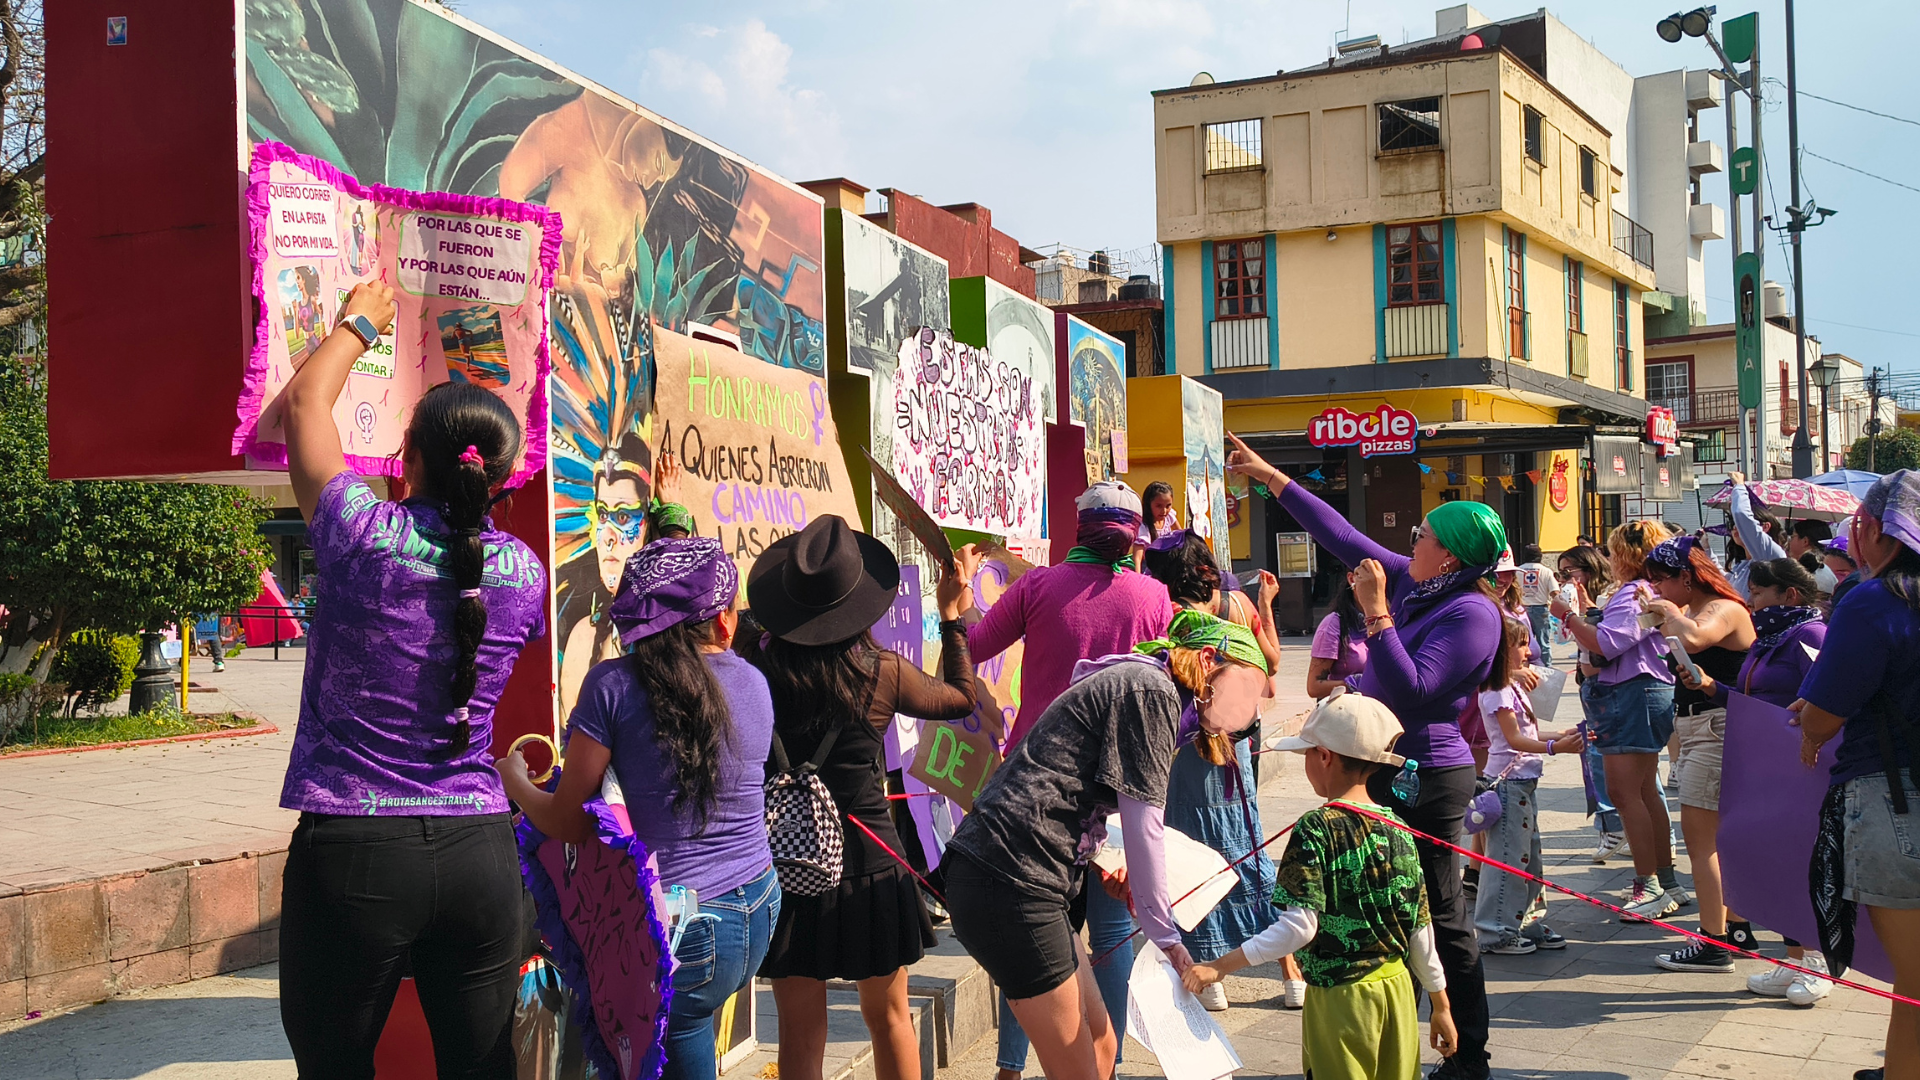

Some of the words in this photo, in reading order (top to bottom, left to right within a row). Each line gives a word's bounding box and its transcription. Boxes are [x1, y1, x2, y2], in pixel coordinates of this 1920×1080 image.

[269, 184, 301, 199] QUIERO
[302, 187, 331, 201] CORRER
[282, 210, 295, 223] EN
[295, 211, 306, 224] LA
[306, 211, 326, 224] PISTA
[417, 216, 445, 231] POR
[447, 220, 471, 234] LAS
[475, 223, 502, 238] QUE
[505, 228, 521, 241] SE
[275, 235, 291, 248] NO
[292, 235, 309, 249] POR
[309, 236, 318, 248] MI
[439, 241, 494, 258] FUERON
[398, 257, 408, 269] Y
[410, 258, 438, 273] POR
[441, 262, 464, 276] LAS
[467, 266, 495, 280] QUE
[497, 269, 525, 284] AÚN
[439, 283, 490, 300] ESTÁN...
[920, 326, 993, 403] ESTAS
[998, 361, 1032, 421] SON
[688, 348, 809, 440] HONRAMOS
[681, 424, 763, 486] QUIENES
[769, 435, 832, 493] ABRIERON
[1362, 439, 1411, 454] pizzas
[933, 452, 1015, 527] FORMAS
[712, 482, 807, 530] CAMINO
[925, 726, 974, 788] DE
